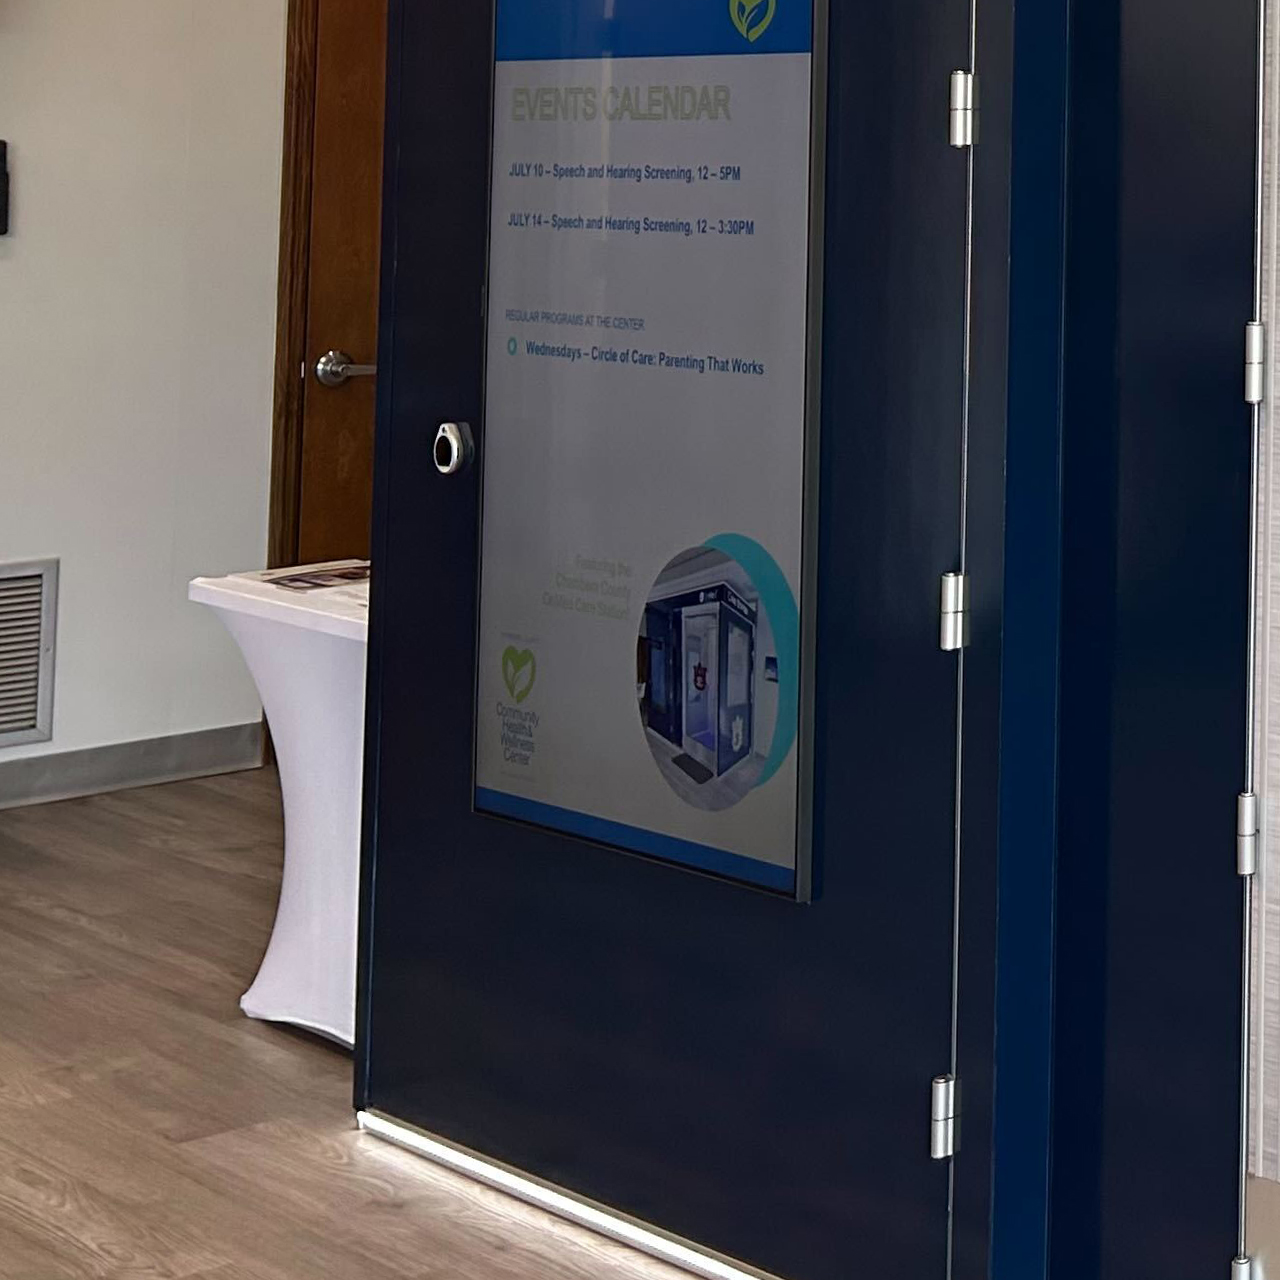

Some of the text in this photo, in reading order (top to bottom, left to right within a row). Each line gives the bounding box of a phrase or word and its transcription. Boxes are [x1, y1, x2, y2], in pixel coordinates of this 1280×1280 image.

[512, 84, 731, 121] EVENTS CALENDAR
[509, 163, 532, 177] JULY
[534, 164, 543, 177] 10
[553, 163, 585, 180] Speech
[587, 165, 604, 178] and
[606, 164, 641, 183] Hearing
[644, 164, 695, 183] Screening,
[697, 166, 708, 180] 12
[720, 166, 740, 180] 5PM
[508, 213, 530, 226] JULY
[532, 214, 542, 226] 14
[551, 214, 584, 231] Speech
[586, 216, 603, 229] and
[605, 216, 640, 234] Hearing
[643, 217, 693, 236] Screening,
[697, 220, 707, 233] 12
[718, 220, 754, 235] 3:30PM
[541, 310, 583, 326] PROGRAMS
[585, 315, 596, 326] AT
[597, 316, 612, 328] THE
[613, 317, 645, 331] CENTER
[526, 340, 581, 362] Wednesdays
[591, 346, 617, 362] Circle
[619, 348, 630, 362] of
[631, 349, 656, 366] Care:
[658, 352, 704, 374] Parenting
[707, 356, 729, 372] That
[731, 358, 764, 375] Works
